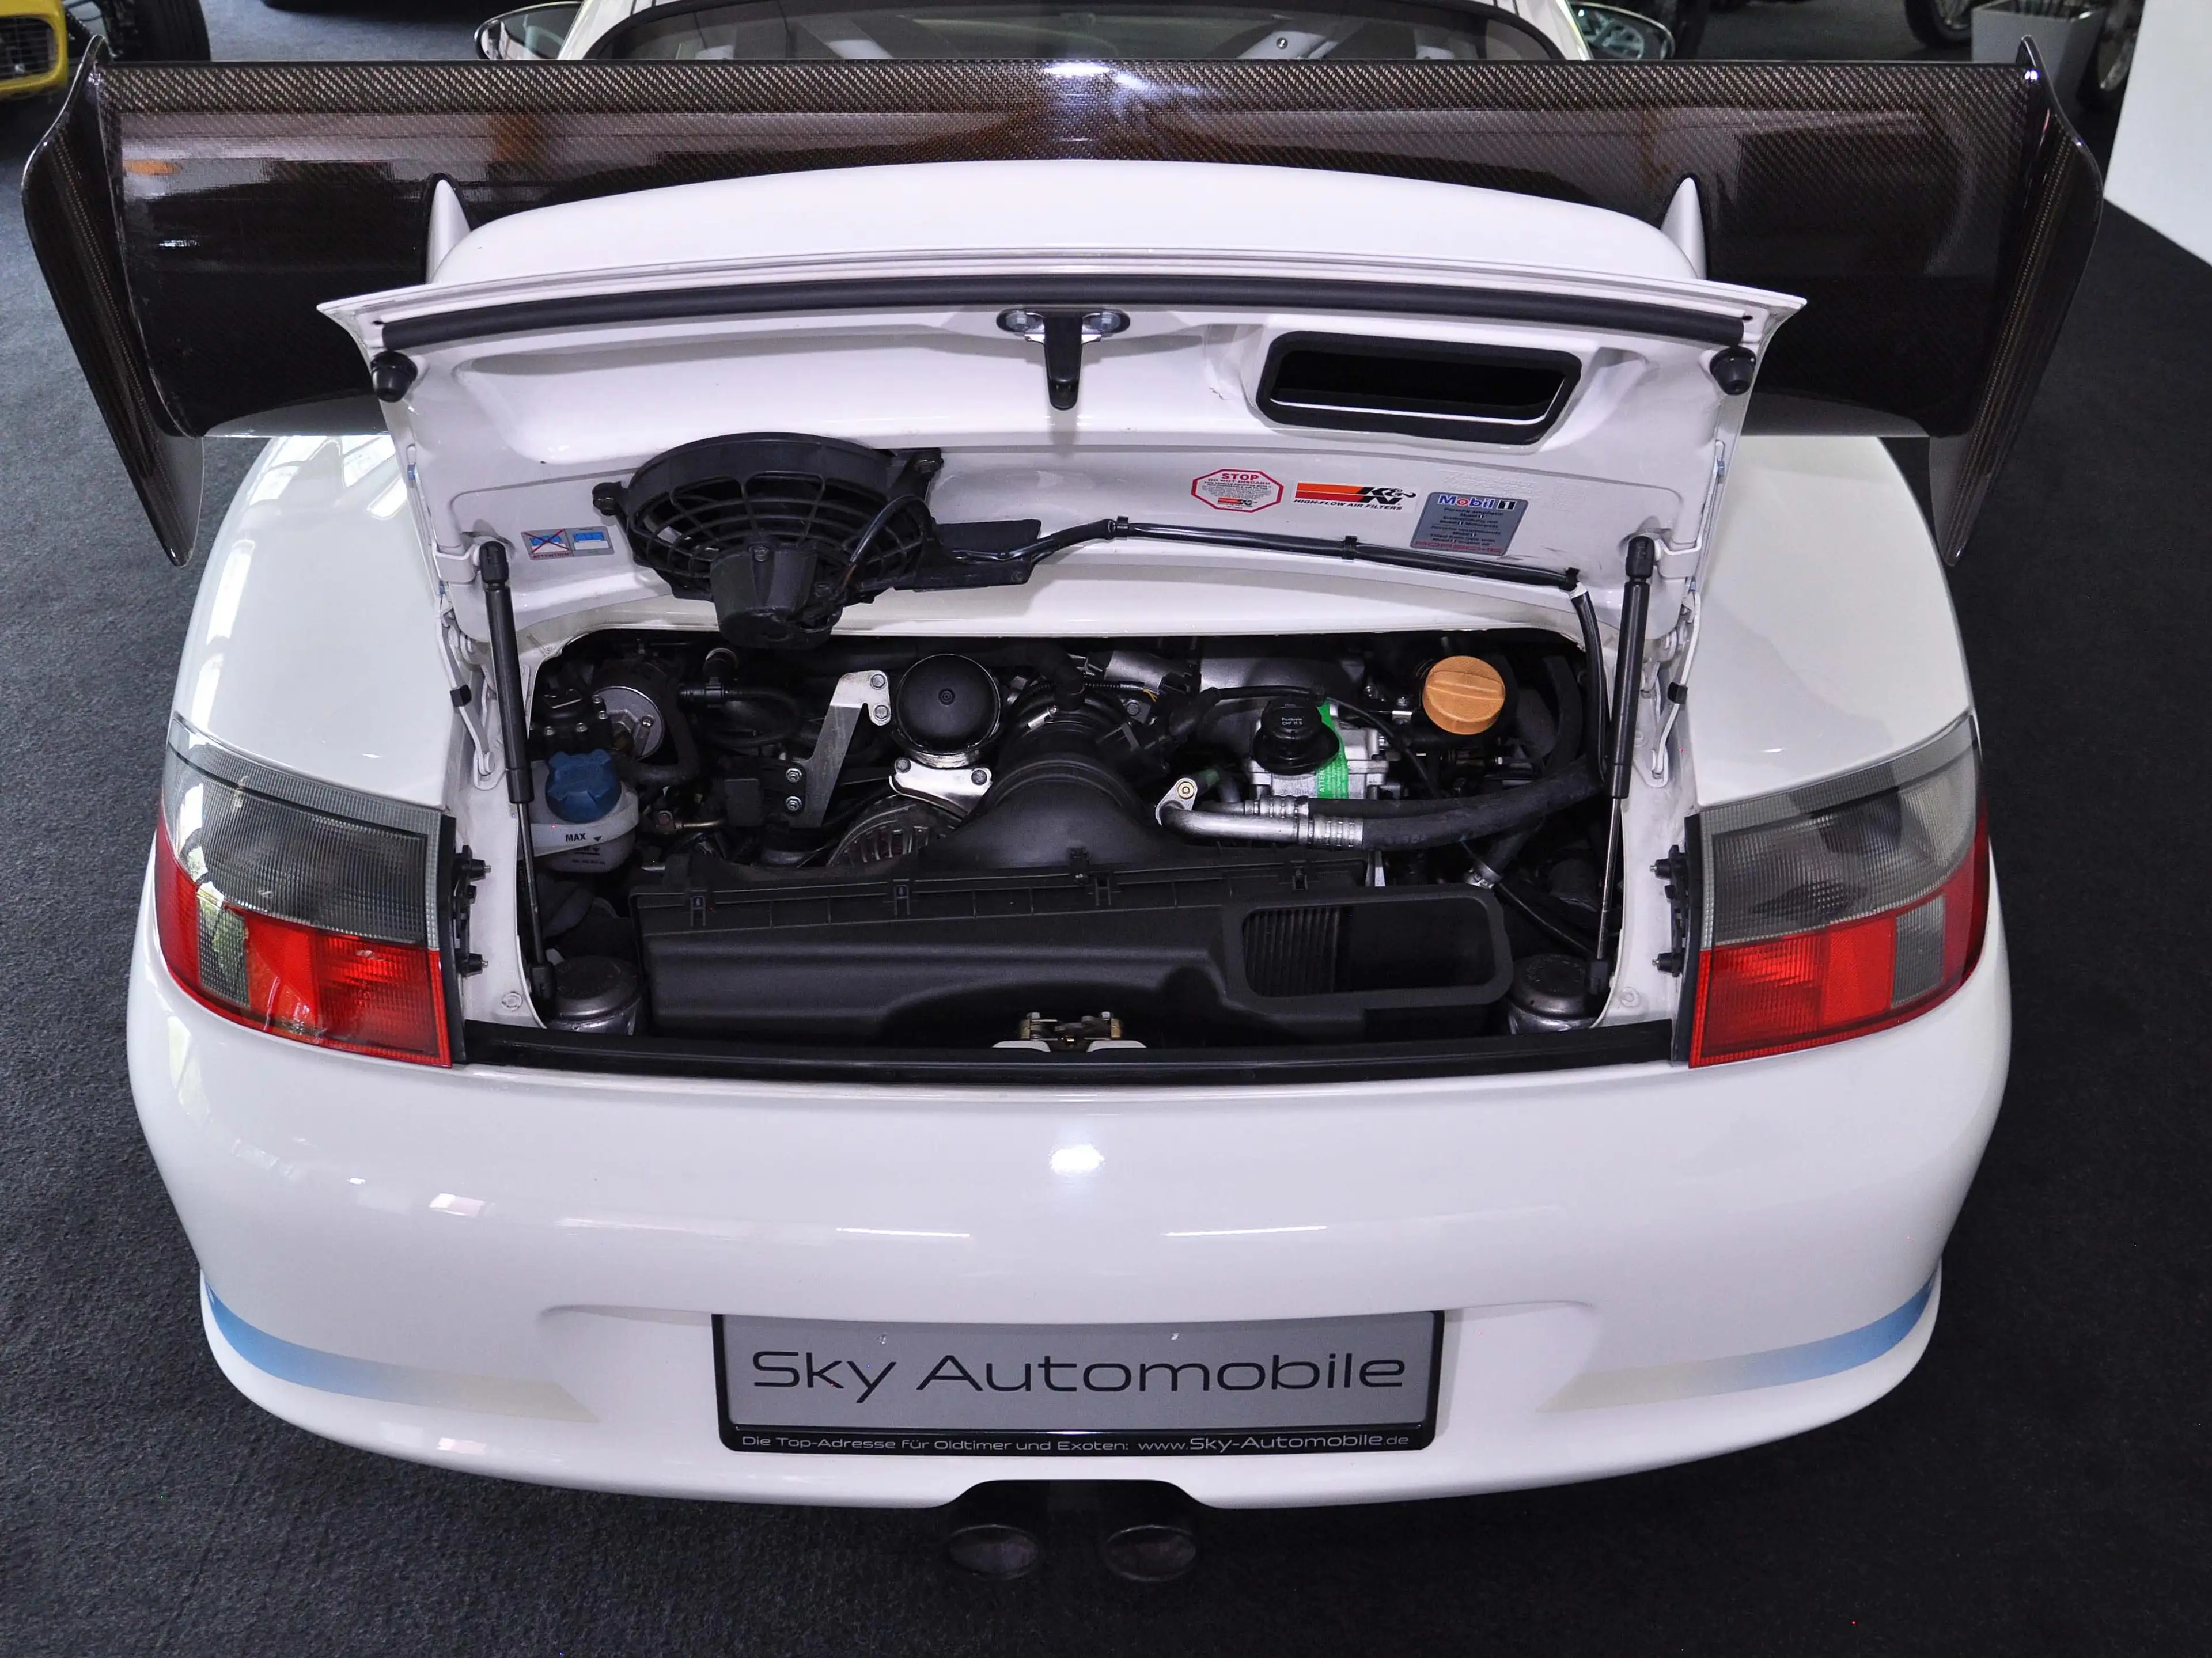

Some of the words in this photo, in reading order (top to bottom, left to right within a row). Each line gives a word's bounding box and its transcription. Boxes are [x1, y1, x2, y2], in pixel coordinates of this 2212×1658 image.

[1221, 473, 1259, 481] STOP
[1294, 499, 1345, 507] HIGH-FLOW
[1438, 494, 1495, 509] Mobil
[1415, 541, 1502, 553] PORSCHE
[565, 833, 586, 843] MAX
[752, 1351, 896, 1403] Sky
[916, 1353, 1406, 1392] Automobile
[742, 1436, 771, 1447] Die
[775, 1437, 896, 1450] Top-Adresse
[902, 1439, 928, 1449] für
[934, 1439, 1012, 1450] Oldtimer
[1016, 1440, 1051, 1450] und
[1058, 1440, 1129, 1451] Exoten:
[1138, 1435, 1409, 1453] www.Sky-Automobile.de
